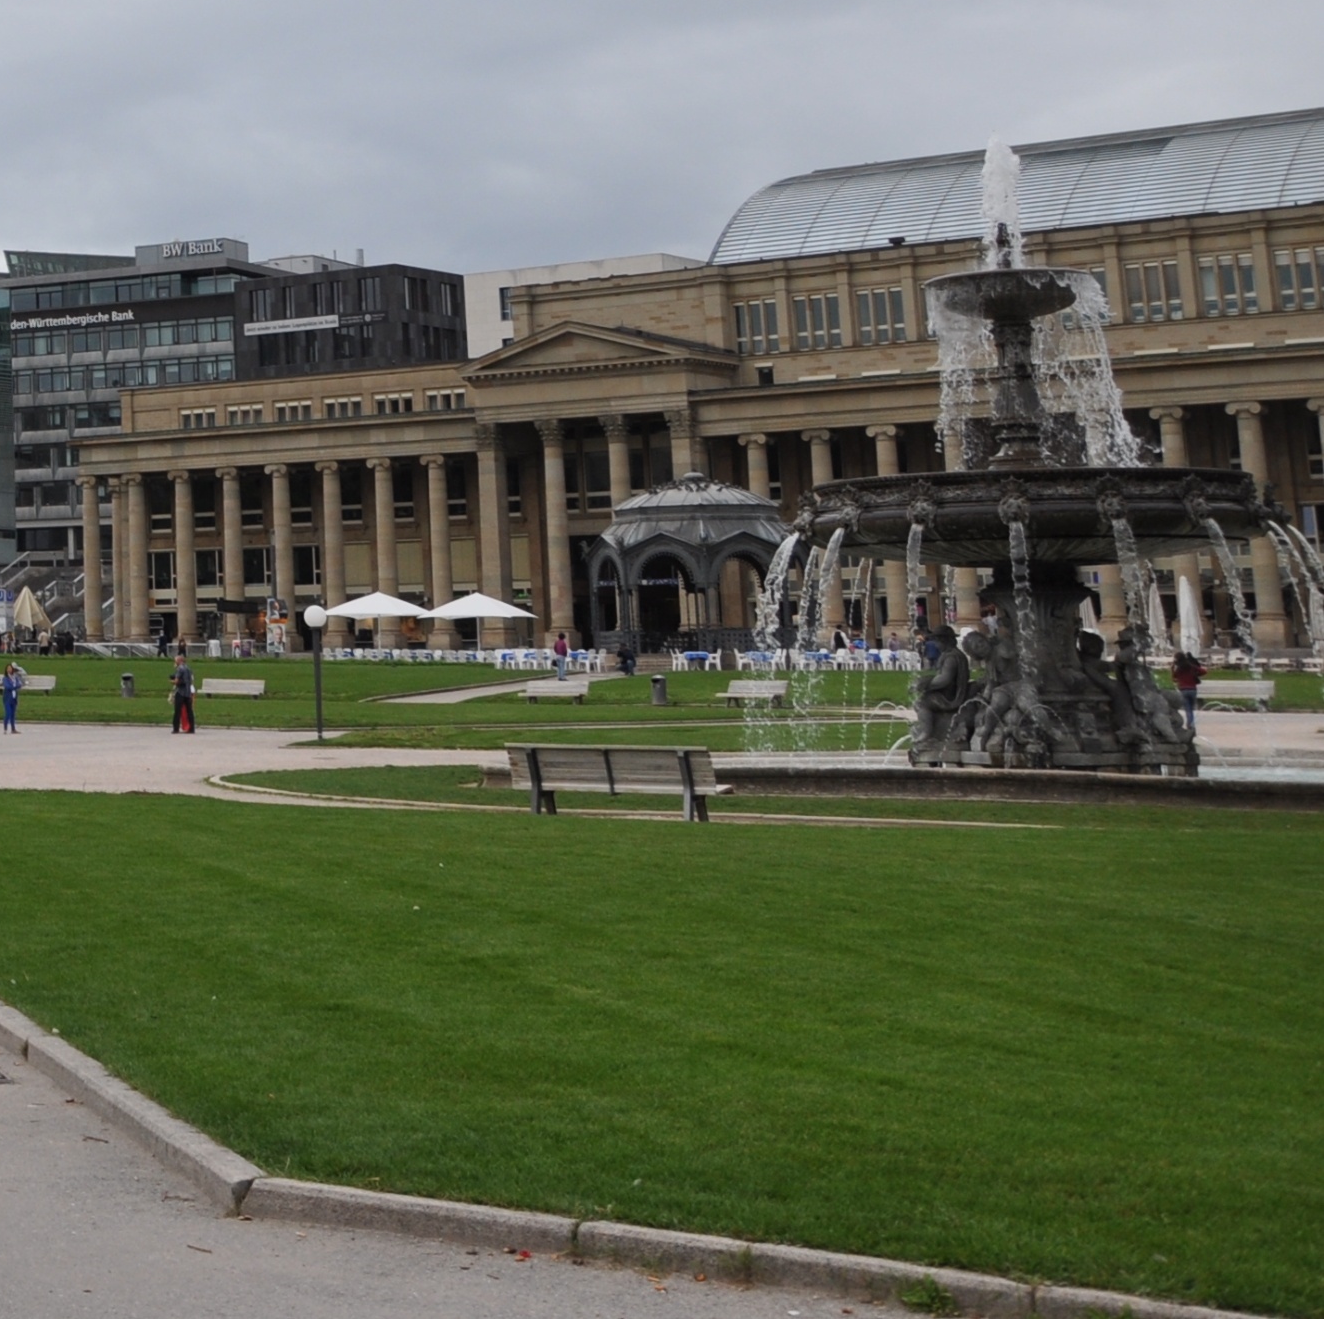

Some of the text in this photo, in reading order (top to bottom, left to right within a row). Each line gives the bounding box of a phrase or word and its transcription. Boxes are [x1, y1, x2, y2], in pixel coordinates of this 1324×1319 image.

[162, 238, 223, 258] BW Bank
[10, 309, 135, 330] den-Württembergische Bank
